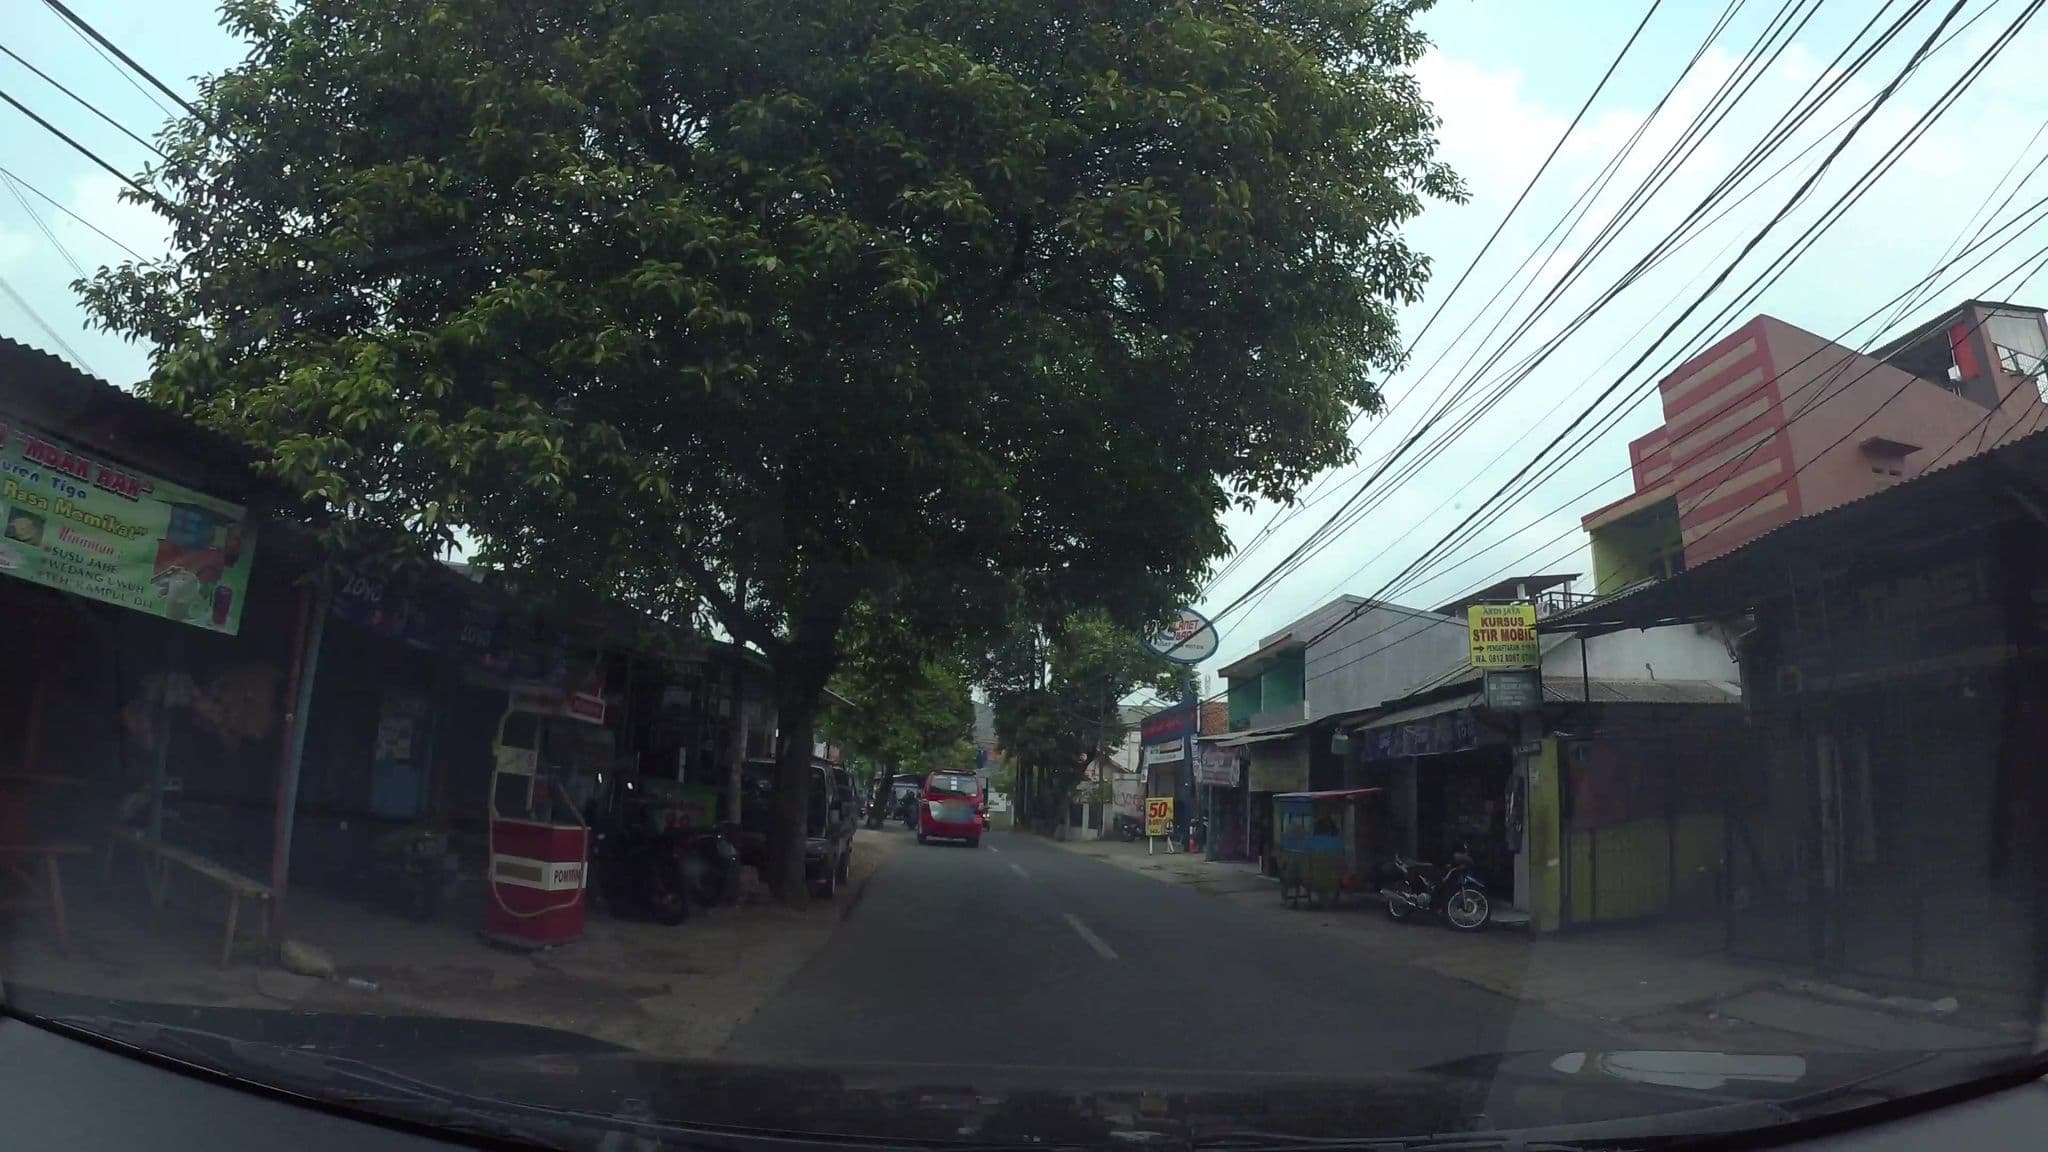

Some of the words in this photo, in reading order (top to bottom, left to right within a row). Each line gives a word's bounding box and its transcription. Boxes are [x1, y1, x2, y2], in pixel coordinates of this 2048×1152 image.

[53, 546, 84, 564] SUSU
[1480, 616, 1525, 628] KURSUS
[1472, 629, 1499, 642] STIR
[1500, 628, 1536, 642] MOBIL
[1148, 802, 1168, 818] 50
